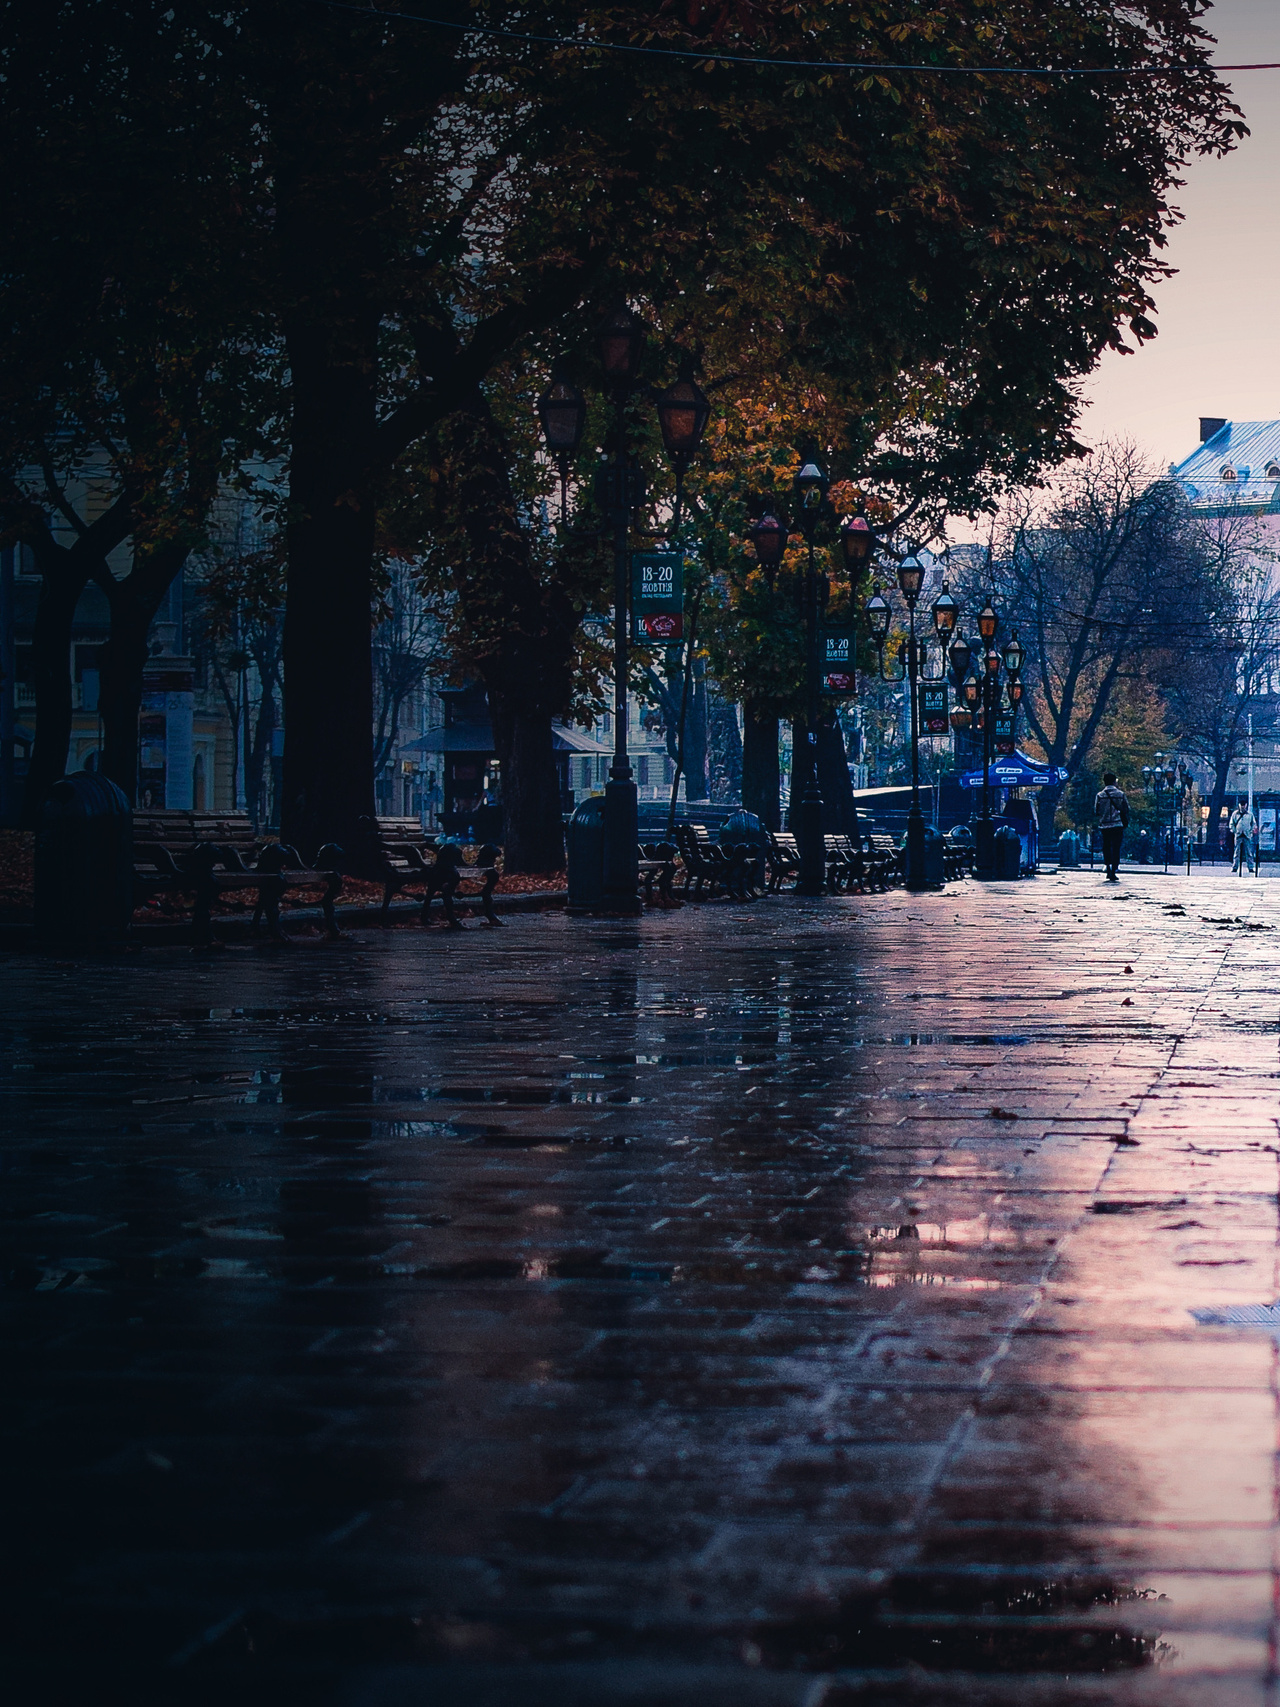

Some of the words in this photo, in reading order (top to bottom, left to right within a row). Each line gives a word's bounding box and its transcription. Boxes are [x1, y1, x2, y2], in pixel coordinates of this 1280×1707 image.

[642, 566, 673, 581] 18-20
[641, 582, 673, 593] ЖОВТНЯ
[826, 638, 849, 650] 18-20
